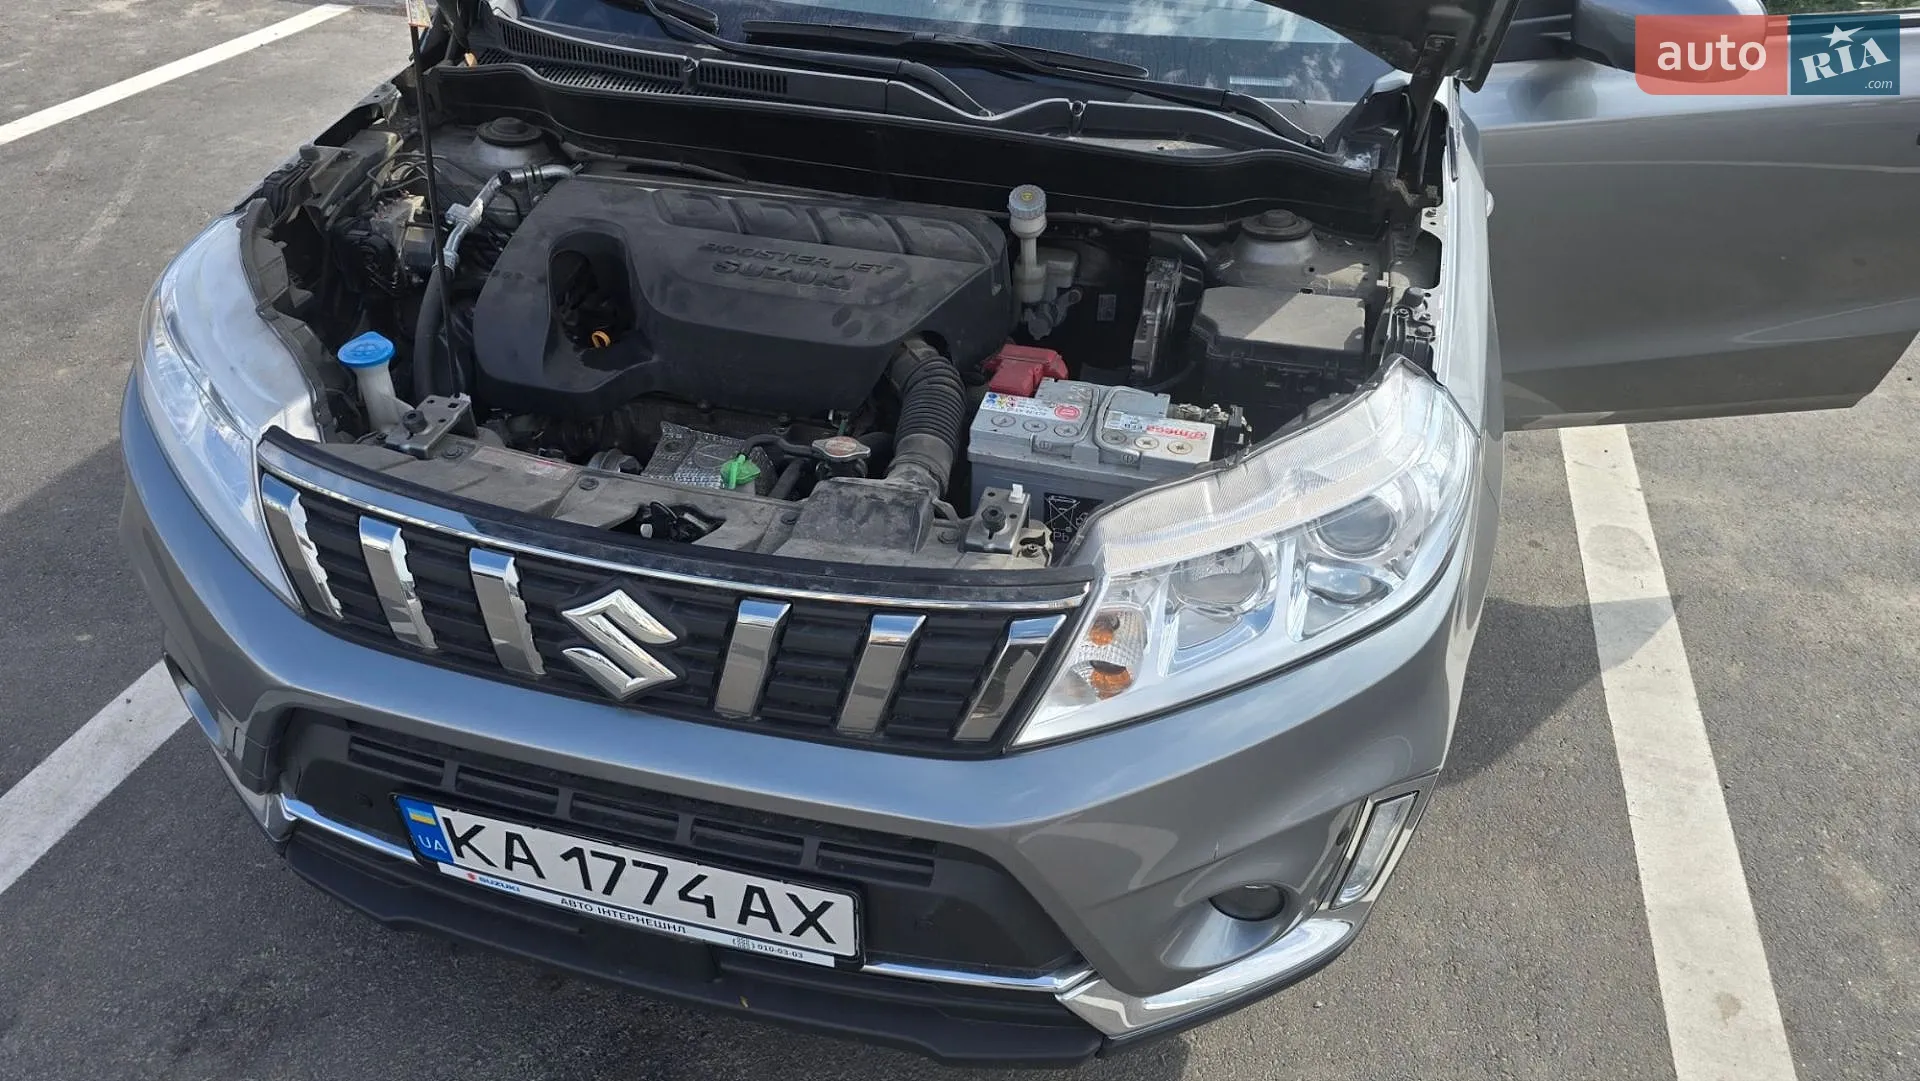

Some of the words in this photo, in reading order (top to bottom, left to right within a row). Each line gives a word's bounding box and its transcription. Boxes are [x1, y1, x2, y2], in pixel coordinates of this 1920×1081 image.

[698, 242, 832, 270] BOOSTER
[834, 260, 895, 275] JET
[712, 258, 855, 291] SUZUKI
[1053, 531, 1070, 543] Pb
[418, 834, 448, 854] UA
[441, 816, 546, 880] KA
[560, 846, 717, 920] 1774
[736, 884, 837, 945] AX
[560, 897, 593, 913] АВТО
